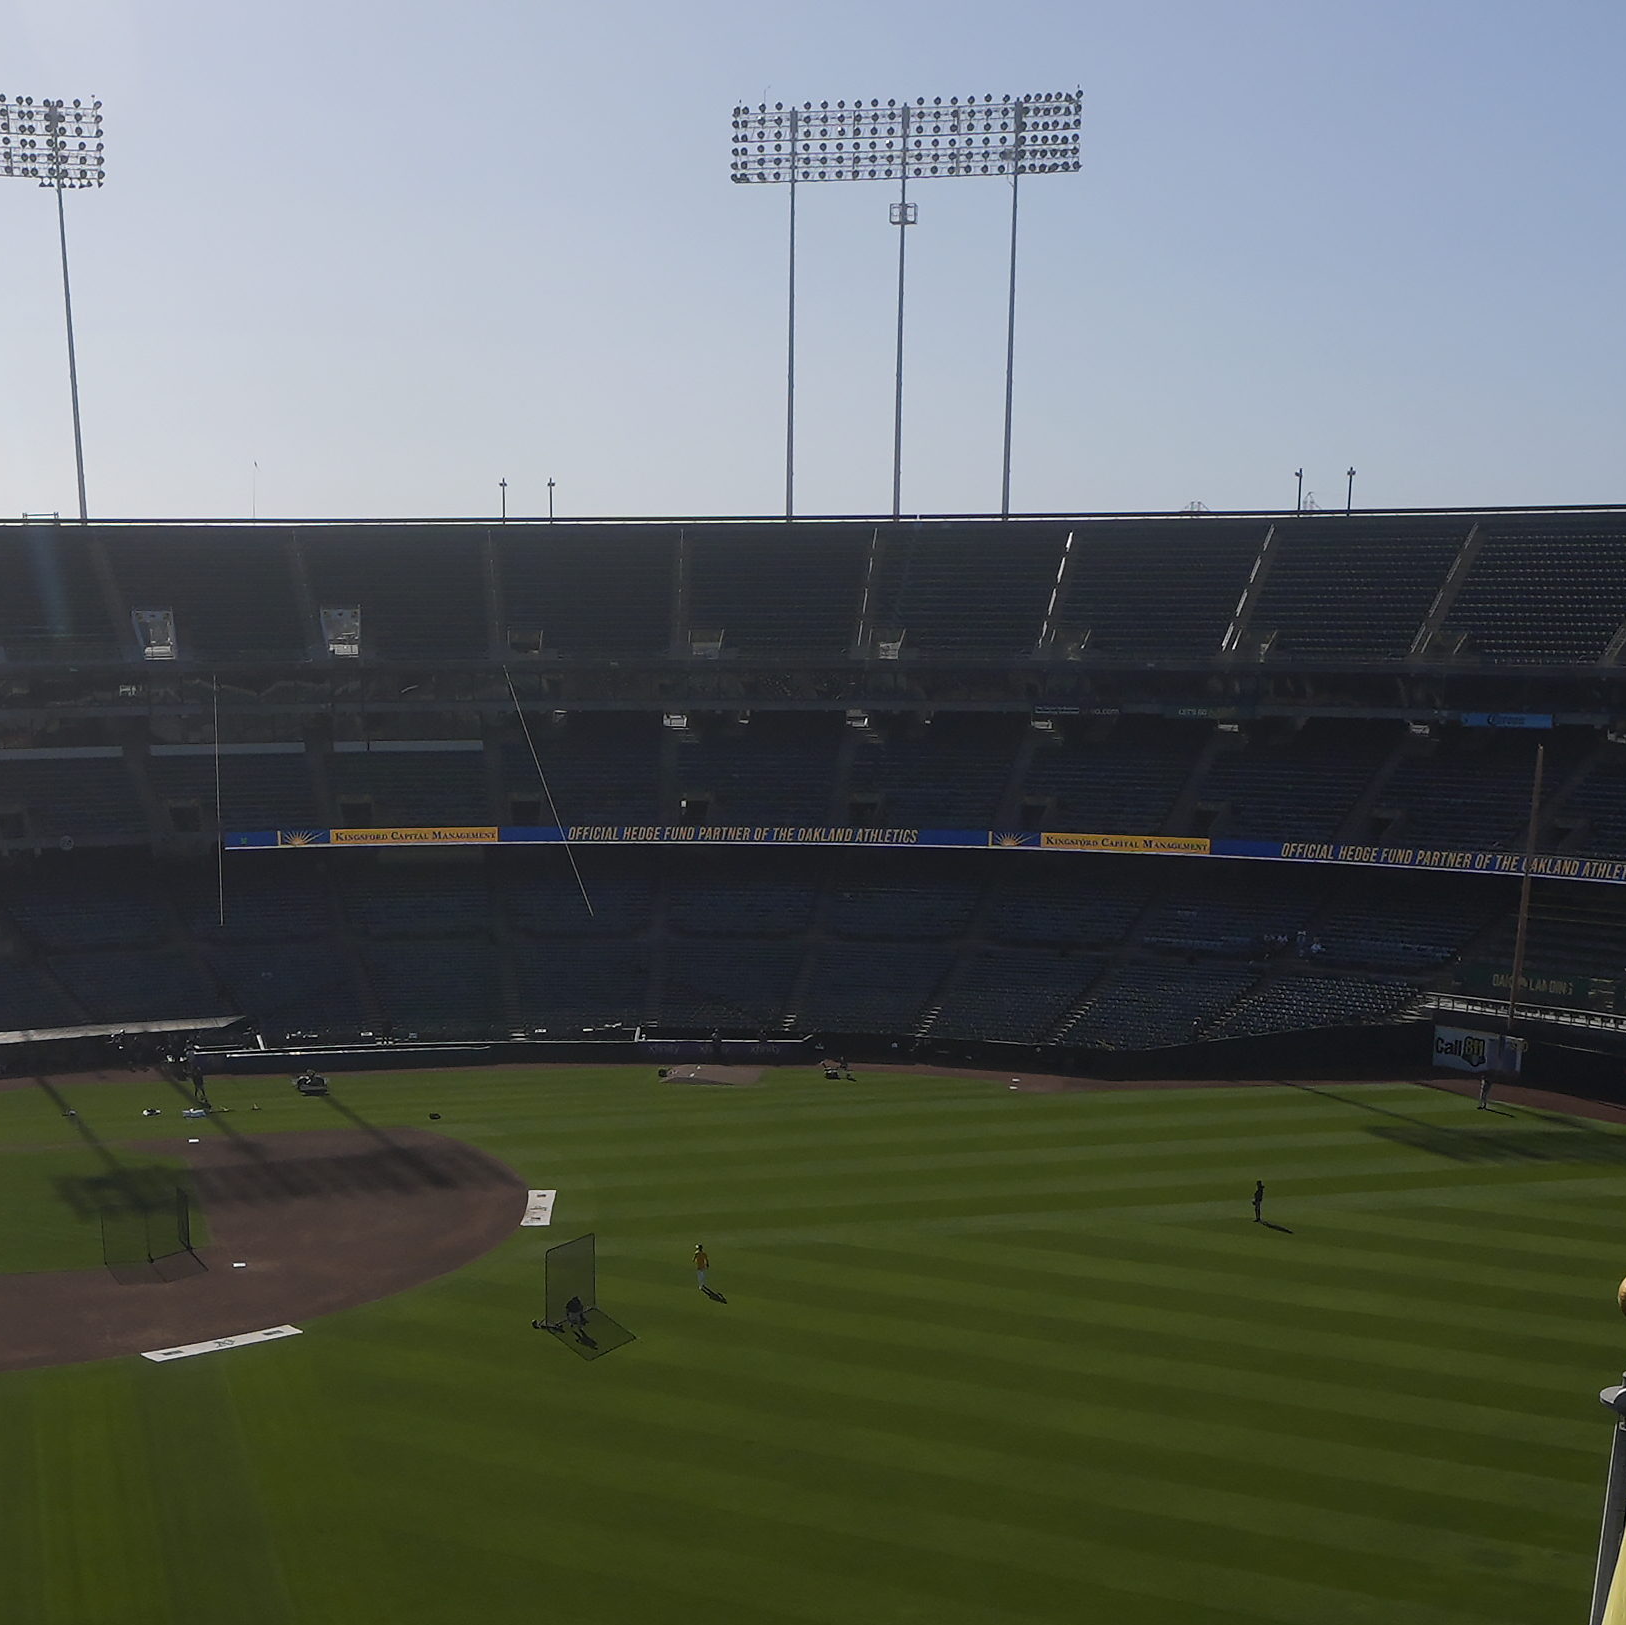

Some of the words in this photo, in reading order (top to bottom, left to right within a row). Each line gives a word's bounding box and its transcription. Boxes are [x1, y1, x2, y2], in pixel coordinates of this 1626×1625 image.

[334, 832, 388, 842] KINGSFORD
[390, 831, 430, 841] CAPITAL
[432, 830, 496, 840] MANAGEMENT
[568, 826, 619, 841] OFFICIAL
[622, 826, 661, 841] HEDGE
[663, 826, 695, 841] FUND
[697, 826, 751, 841] PARTNER
[753, 827, 770, 841] OF
[773, 827, 794, 841] THE
[797, 827, 853, 842] OAKLAND
[855, 828, 919, 843] ATHLETICS
[1045, 836, 1098, 847] KINGSFORD
[1101, 838, 1140, 849] CAPITAL
[1142, 839, 1208, 851] MANAGEMENT
[1281, 842, 1334, 860] OFFICIAL
[1338, 845, 1379, 863] HEDGE
[1380, 848, 1413, 865] FUND
[1415, 850, 1472, 869] PARTNER
[1474, 853, 1491, 870] OF
[1495, 854, 1518, 871] THE
[1435, 1037, 1463, 1056] Call
[1464, 1036, 1485, 1055] 811
